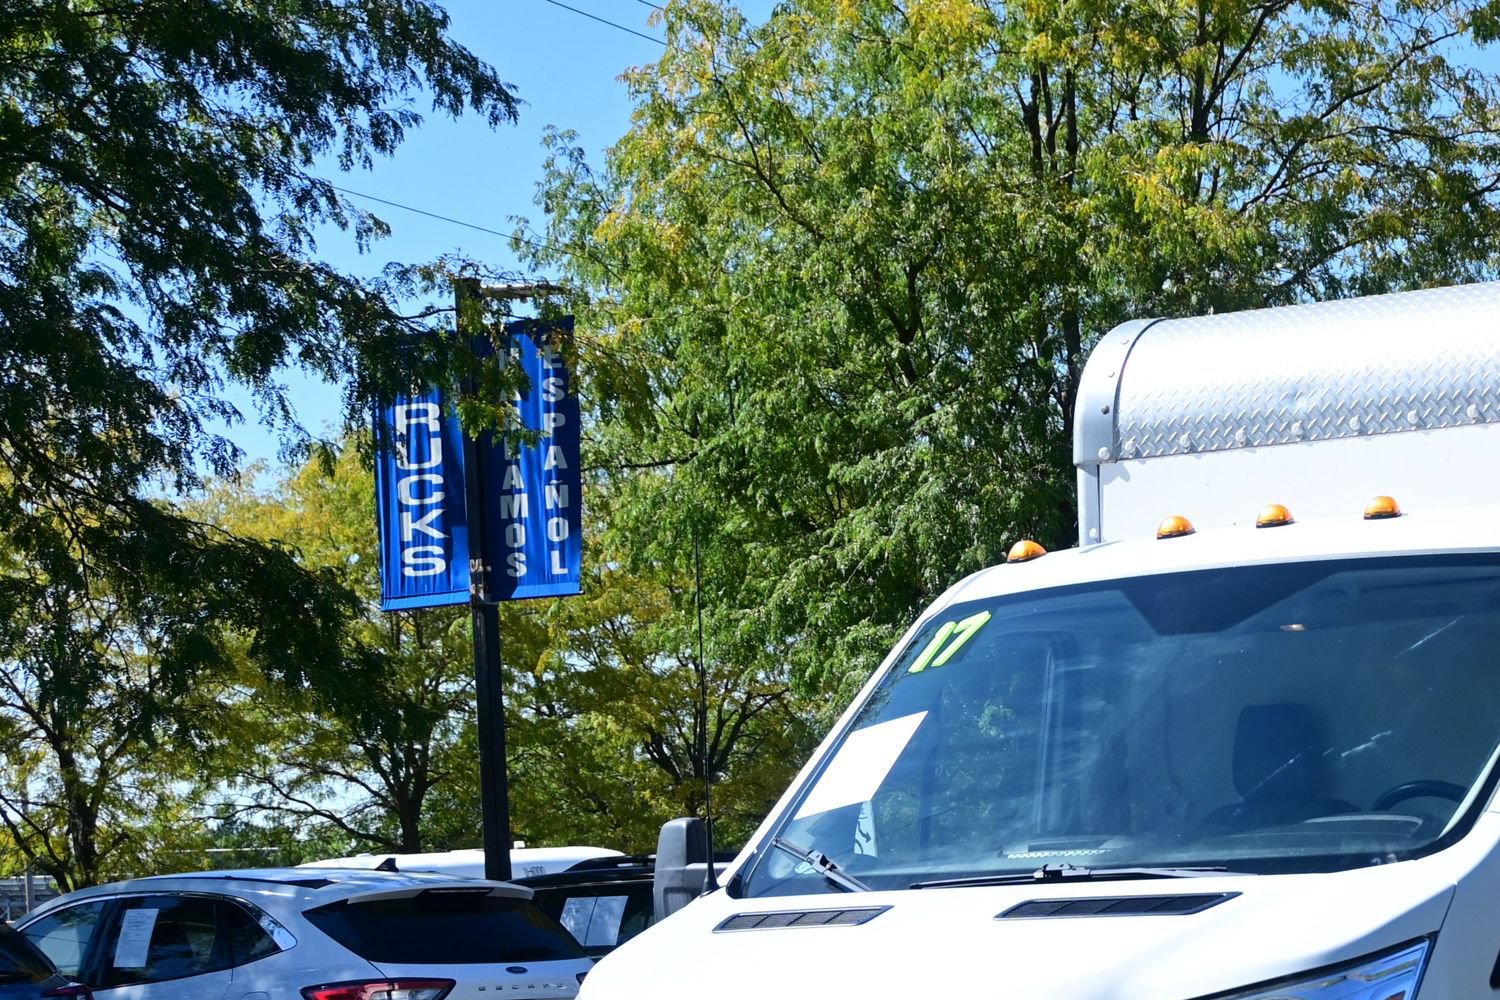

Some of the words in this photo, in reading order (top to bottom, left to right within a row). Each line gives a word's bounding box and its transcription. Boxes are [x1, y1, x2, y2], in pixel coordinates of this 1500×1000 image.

[395, 401, 449, 578] RUCKS
[542, 343, 570, 575] ESPAÑOL
[908, 610, 992, 674] 17
